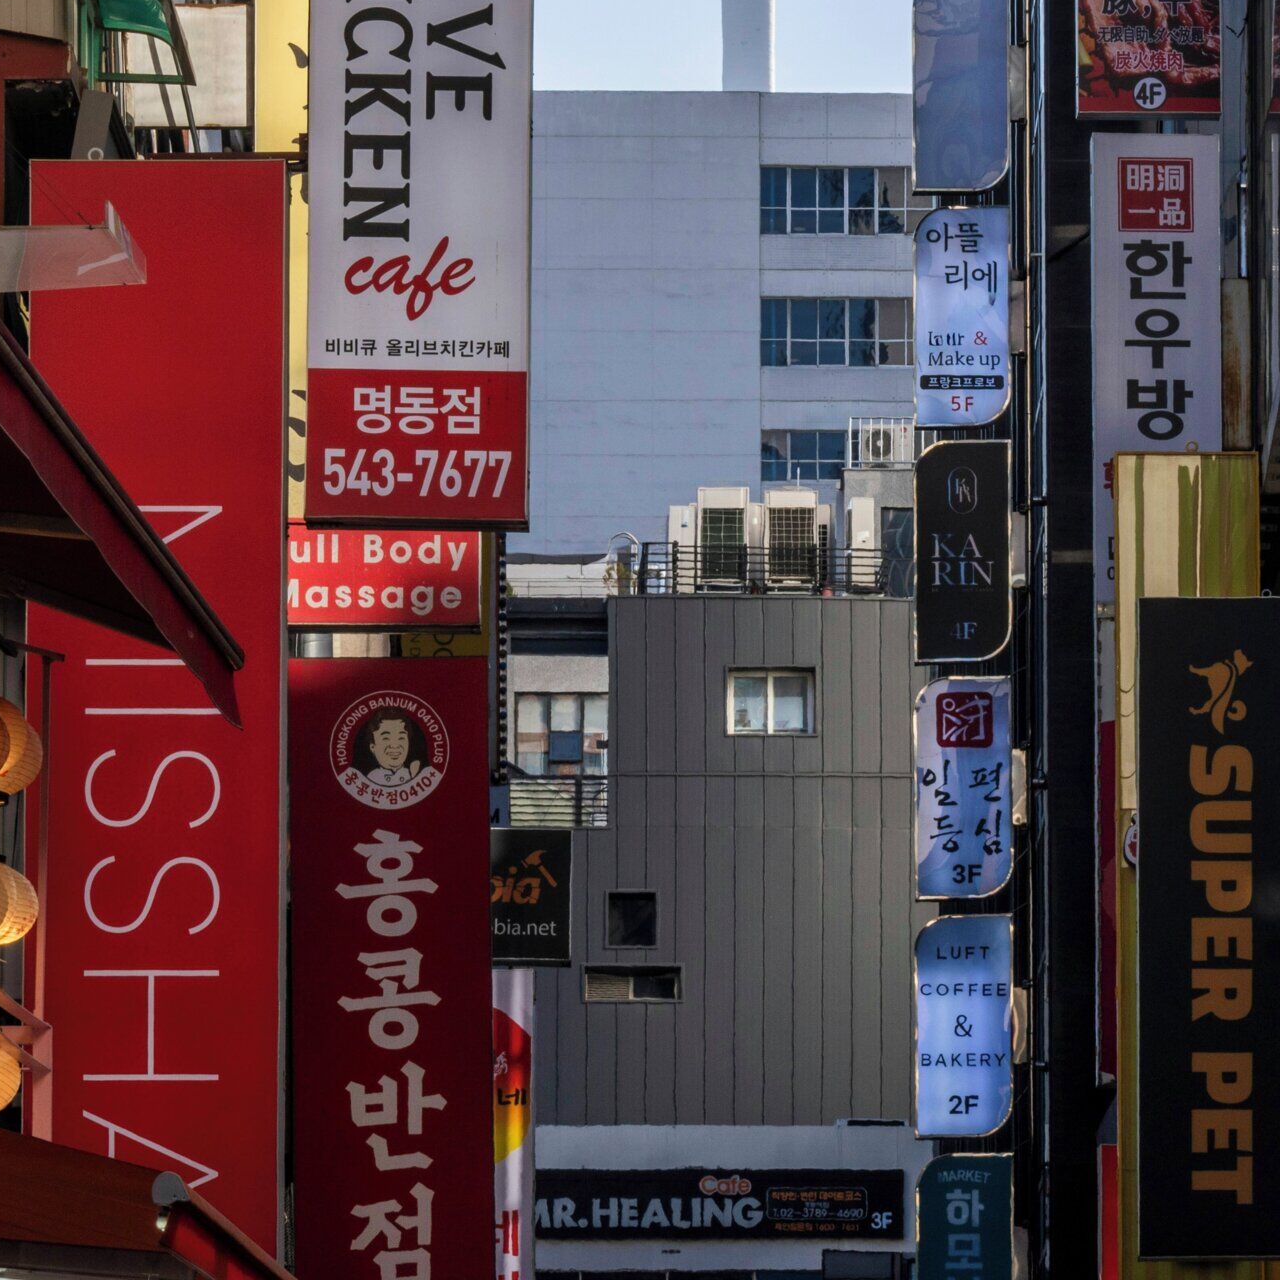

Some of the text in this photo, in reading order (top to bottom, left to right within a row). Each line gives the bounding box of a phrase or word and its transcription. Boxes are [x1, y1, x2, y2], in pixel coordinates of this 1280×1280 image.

[1135, 82, 1163, 106] 4F
[344, 236, 476, 321] cafe
[324, 338, 511, 359] 비비큐 올리브치킨카페
[1122, 239, 1194, 441] 한우방
[927, 351, 1001, 370] Make up
[353, 385, 482, 436] 명동점
[951, 395, 974, 412] 5F
[323, 448, 512, 498] 543-7677
[289, 534, 469, 571] ull Body
[951, 622, 978, 640] 4F
[337, 696, 444, 766] HONGKONG BANJUM 0410 PLUS
[952, 864, 982, 884] 3F
[936, 945, 990, 960] LUFT
[1189, 744, 1254, 1205] SUPER PET
[920, 982, 1008, 996] COFFEE
[954, 1014, 973, 1037] &
[334, 828, 448, 1280] 홍콩반점
[920, 1053, 1006, 1068] BAKERY
[949, 1095, 979, 1115] 2F
[698, 1174, 752, 1195] Cafe
[938, 1169, 992, 1184] MARKET
[871, 1211, 893, 1230] 3F
